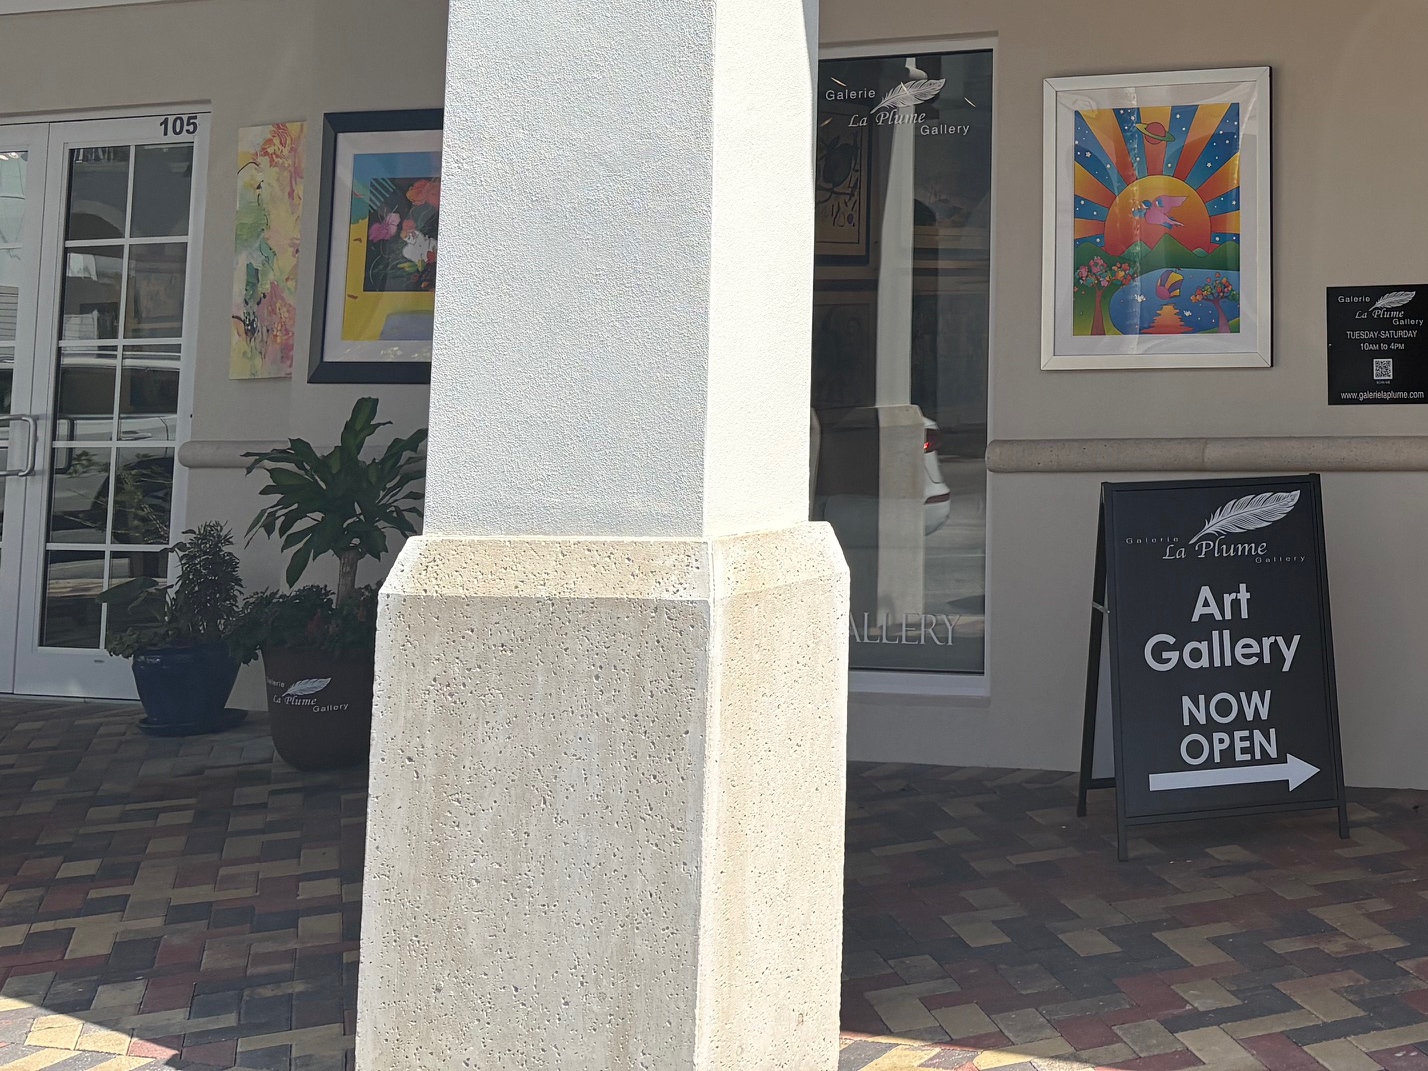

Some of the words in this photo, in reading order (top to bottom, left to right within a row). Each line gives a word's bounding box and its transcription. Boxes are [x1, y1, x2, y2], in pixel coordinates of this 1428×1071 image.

[825, 88, 876, 101] Galerie
[848, 114, 868, 127] La
[875, 108, 926, 126] Plume
[160, 115, 198, 136] 105
[920, 124, 970, 136] Gallery
[1338, 295, 1371, 303] Galerie
[1355, 311, 1368, 319] La
[1372, 308, 1404, 319] Plume
[1393, 318, 1424, 326] Gallery
[1346, 330, 1418, 339] TUESDAY-SATURDAY
[1341, 390, 1425, 401] www.galerielaplume.com
[1126, 536, 1179, 544] Galerie
[1162, 544, 1186, 559] La
[1195, 536, 1268, 559] Plume
[1255, 554, 1307, 564] Gallery
[1191, 583, 1250, 622] Art
[1144, 629, 1301, 672] Gallery
[273, 695, 281, 703] La
[284, 695, 317, 706] Plume
[312, 704, 349, 712] Gallery
[1181, 689, 1271, 726] NOW
[1180, 728, 1278, 766] OPEN
